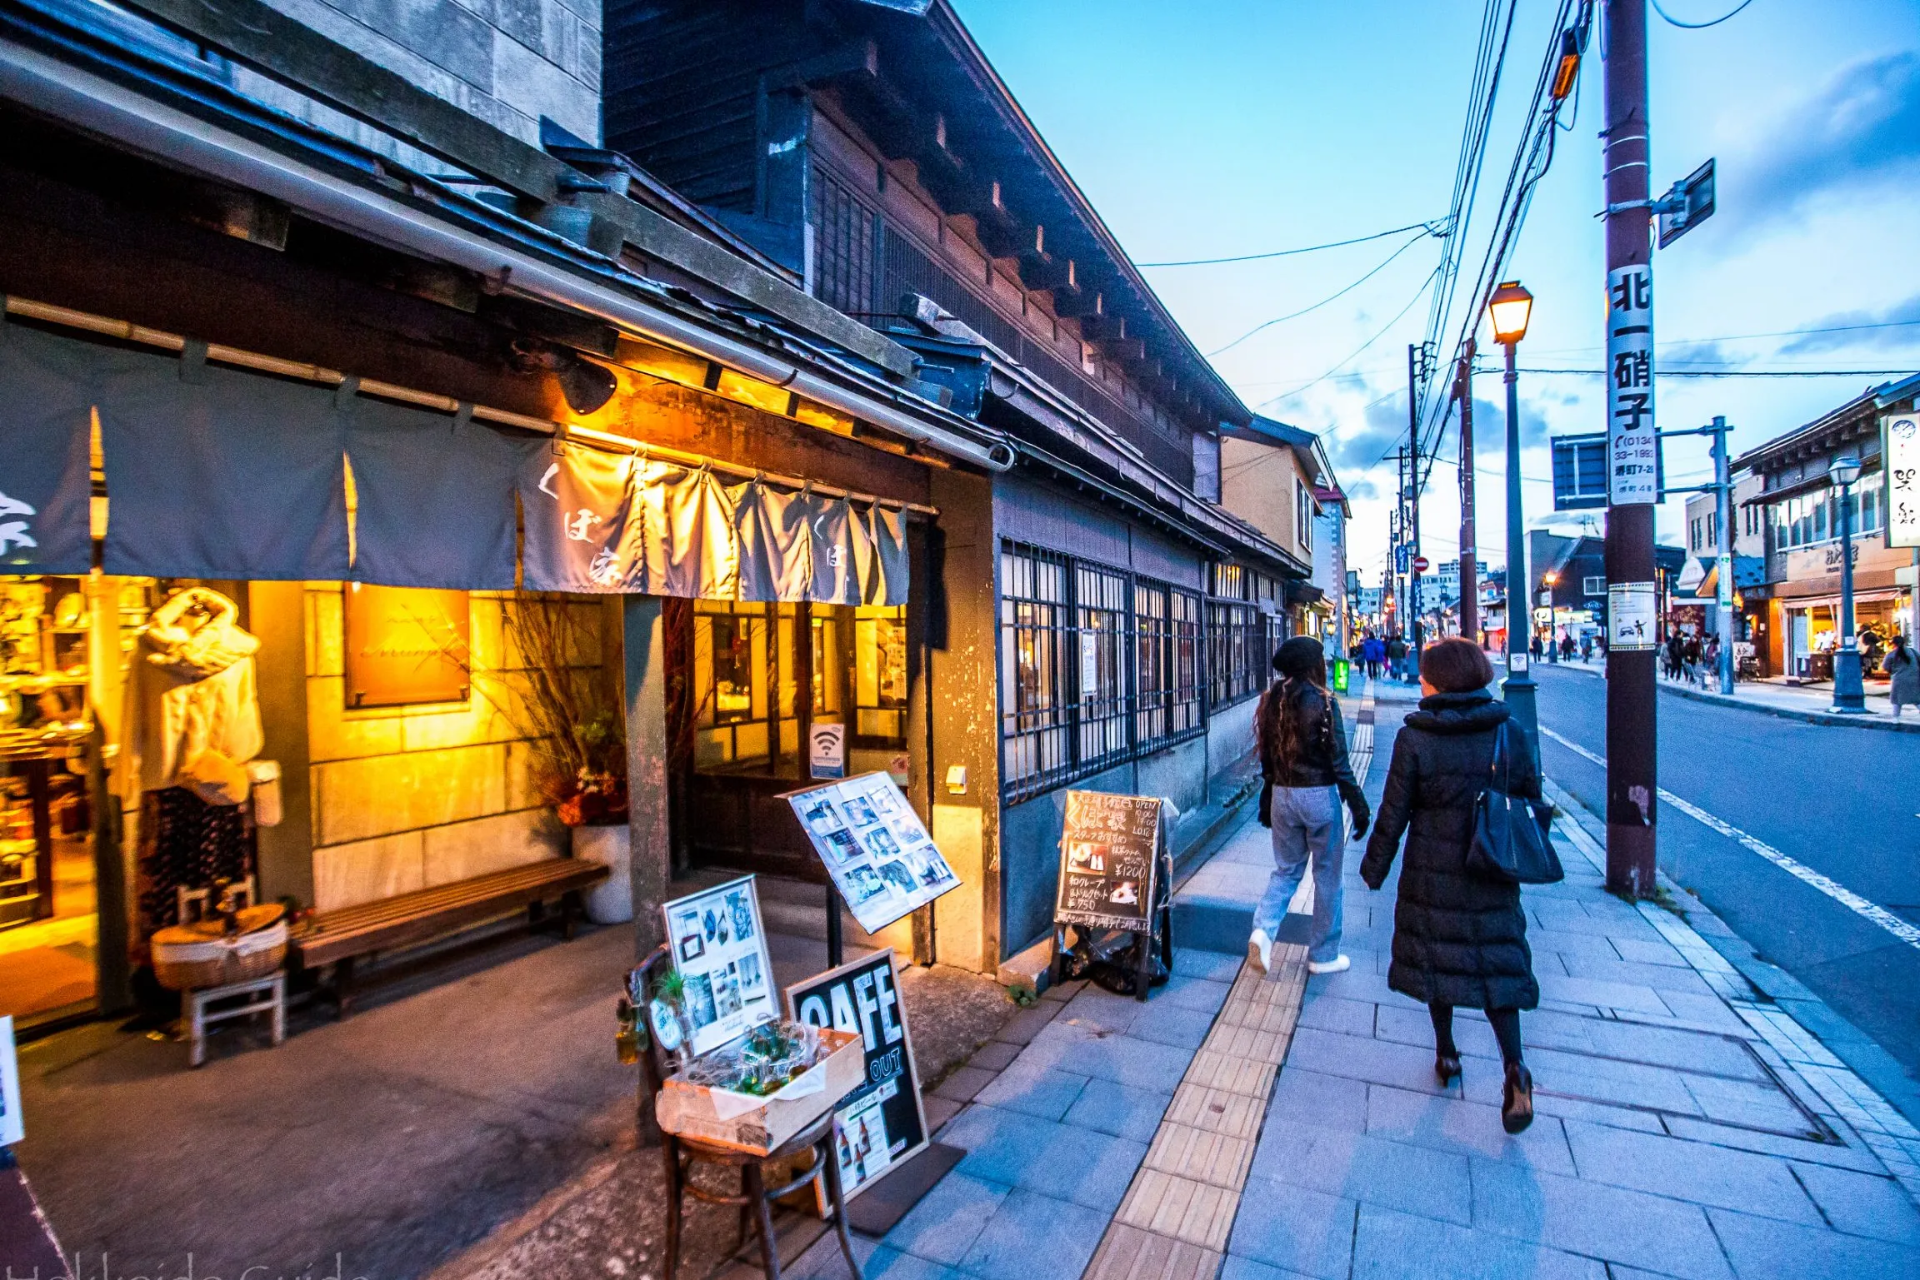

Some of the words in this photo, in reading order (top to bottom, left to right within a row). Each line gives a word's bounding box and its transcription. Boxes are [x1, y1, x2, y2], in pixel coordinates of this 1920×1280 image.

[1612, 271, 1652, 431] 北一硝子
[538, 463, 622, 586] くぼ家
[1136, 801, 1156, 809] OPEN
[870, 1047, 900, 1081] OUT
